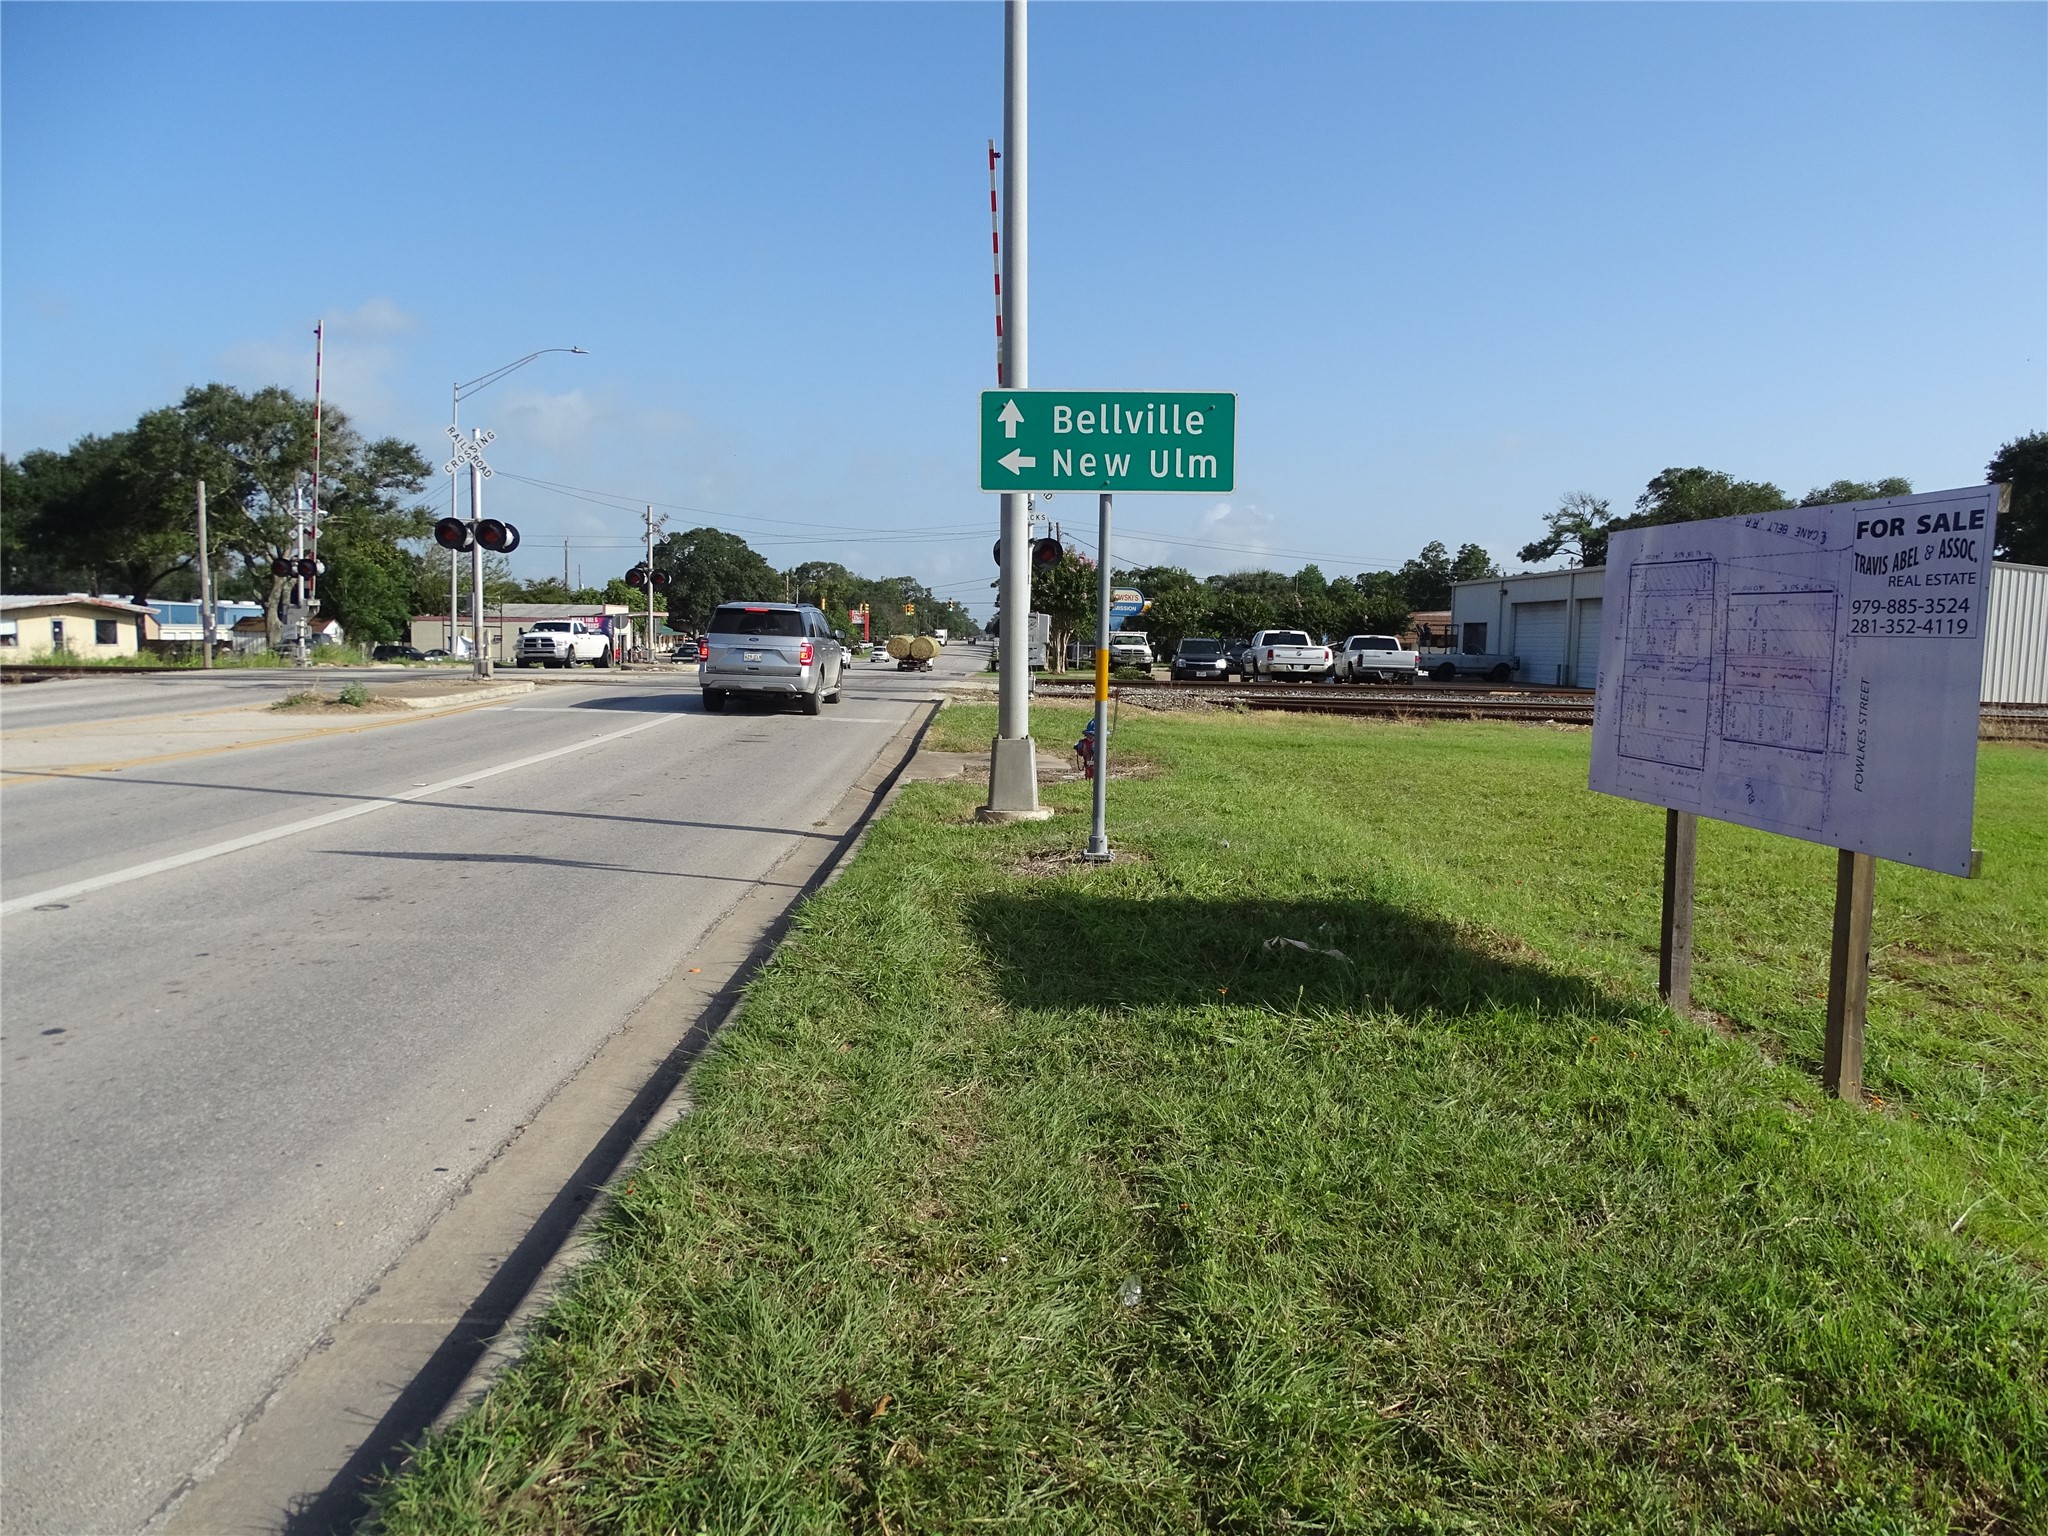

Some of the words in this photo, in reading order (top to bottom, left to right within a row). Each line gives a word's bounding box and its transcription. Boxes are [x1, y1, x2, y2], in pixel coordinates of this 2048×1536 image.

[1053, 403, 1204, 435] Bellville
[1052, 449, 1131, 477] New
[1150, 448, 1217, 478] Ulm
[1767, 522, 1789, 534] BELT
[1795, 527, 1819, 541] CANE
[1856, 518, 1905, 539] FOR
[1916, 509, 1985, 534] SALE
[1854, 552, 1888, 575] TRAVIS
[1892, 546, 1919, 572] ABEL
[1924, 544, 1934, 560] &
[1938, 537, 1977, 563] ASSOC.
[1888, 575, 1921, 587] REAL
[1925, 572, 1976, 586] ESTATE
[1852, 597, 1970, 614] 979-885-3524
[1850, 618, 1968, 634] 281-352-4119
[1858, 677, 1871, 725] STREET
[1854, 729, 1867, 793] FOWLKES
